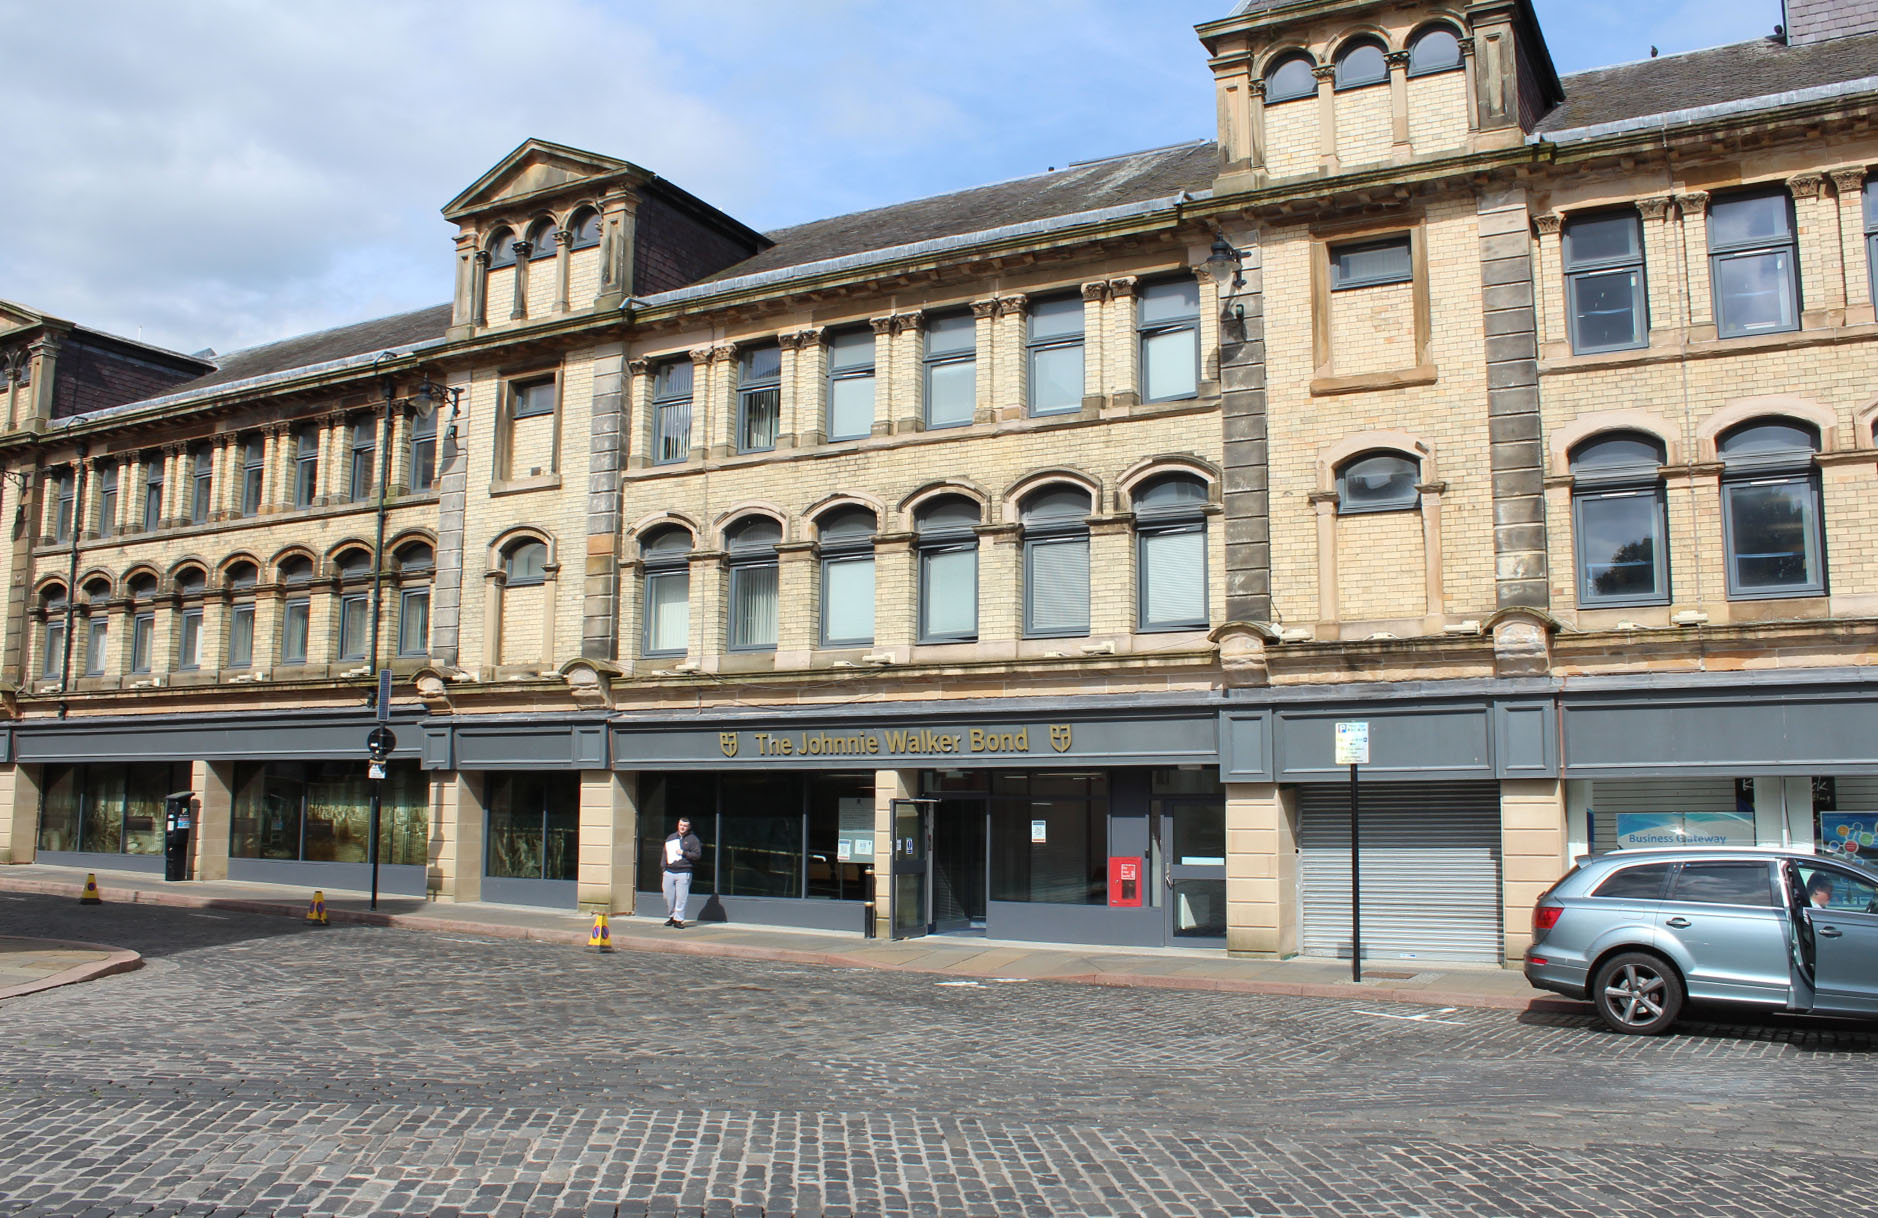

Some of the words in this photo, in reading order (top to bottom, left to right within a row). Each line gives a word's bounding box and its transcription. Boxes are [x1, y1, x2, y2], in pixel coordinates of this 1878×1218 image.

[756, 733, 793, 755] The
[799, 731, 878, 755] Johnnie
[885, 730, 961, 753] Walker
[969, 728, 1029, 751] Bond
[1628, 834, 1674, 843] Business
[1677, 834, 1727, 844] Gateway
